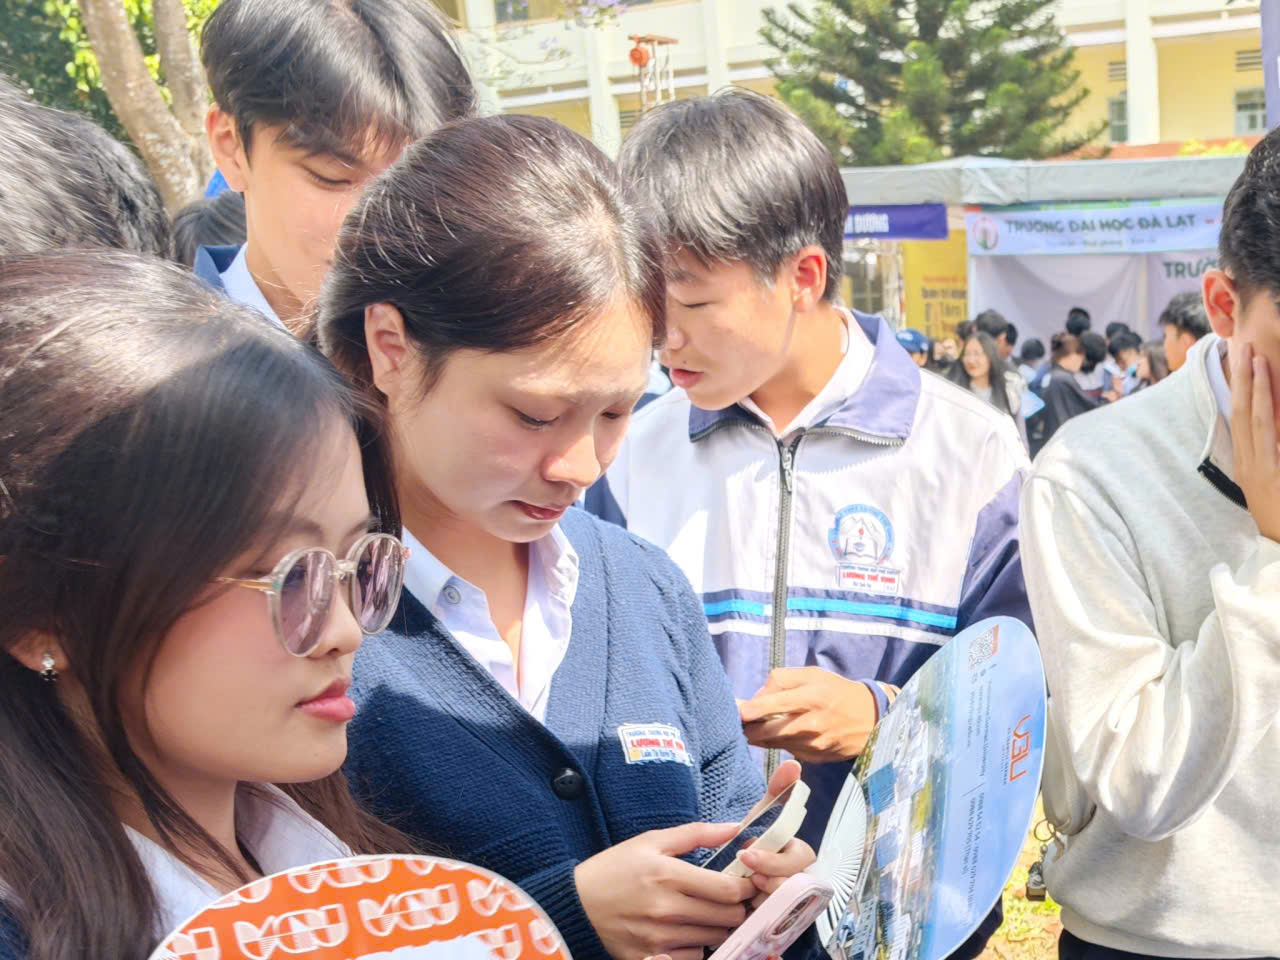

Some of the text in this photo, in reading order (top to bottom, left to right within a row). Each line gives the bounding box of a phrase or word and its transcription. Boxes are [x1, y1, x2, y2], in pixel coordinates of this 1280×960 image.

[1100, 218, 1134, 233] HỌC
[1138, 214, 1163, 231] ĐÀ
[1166, 213, 1196, 231] LẠT
